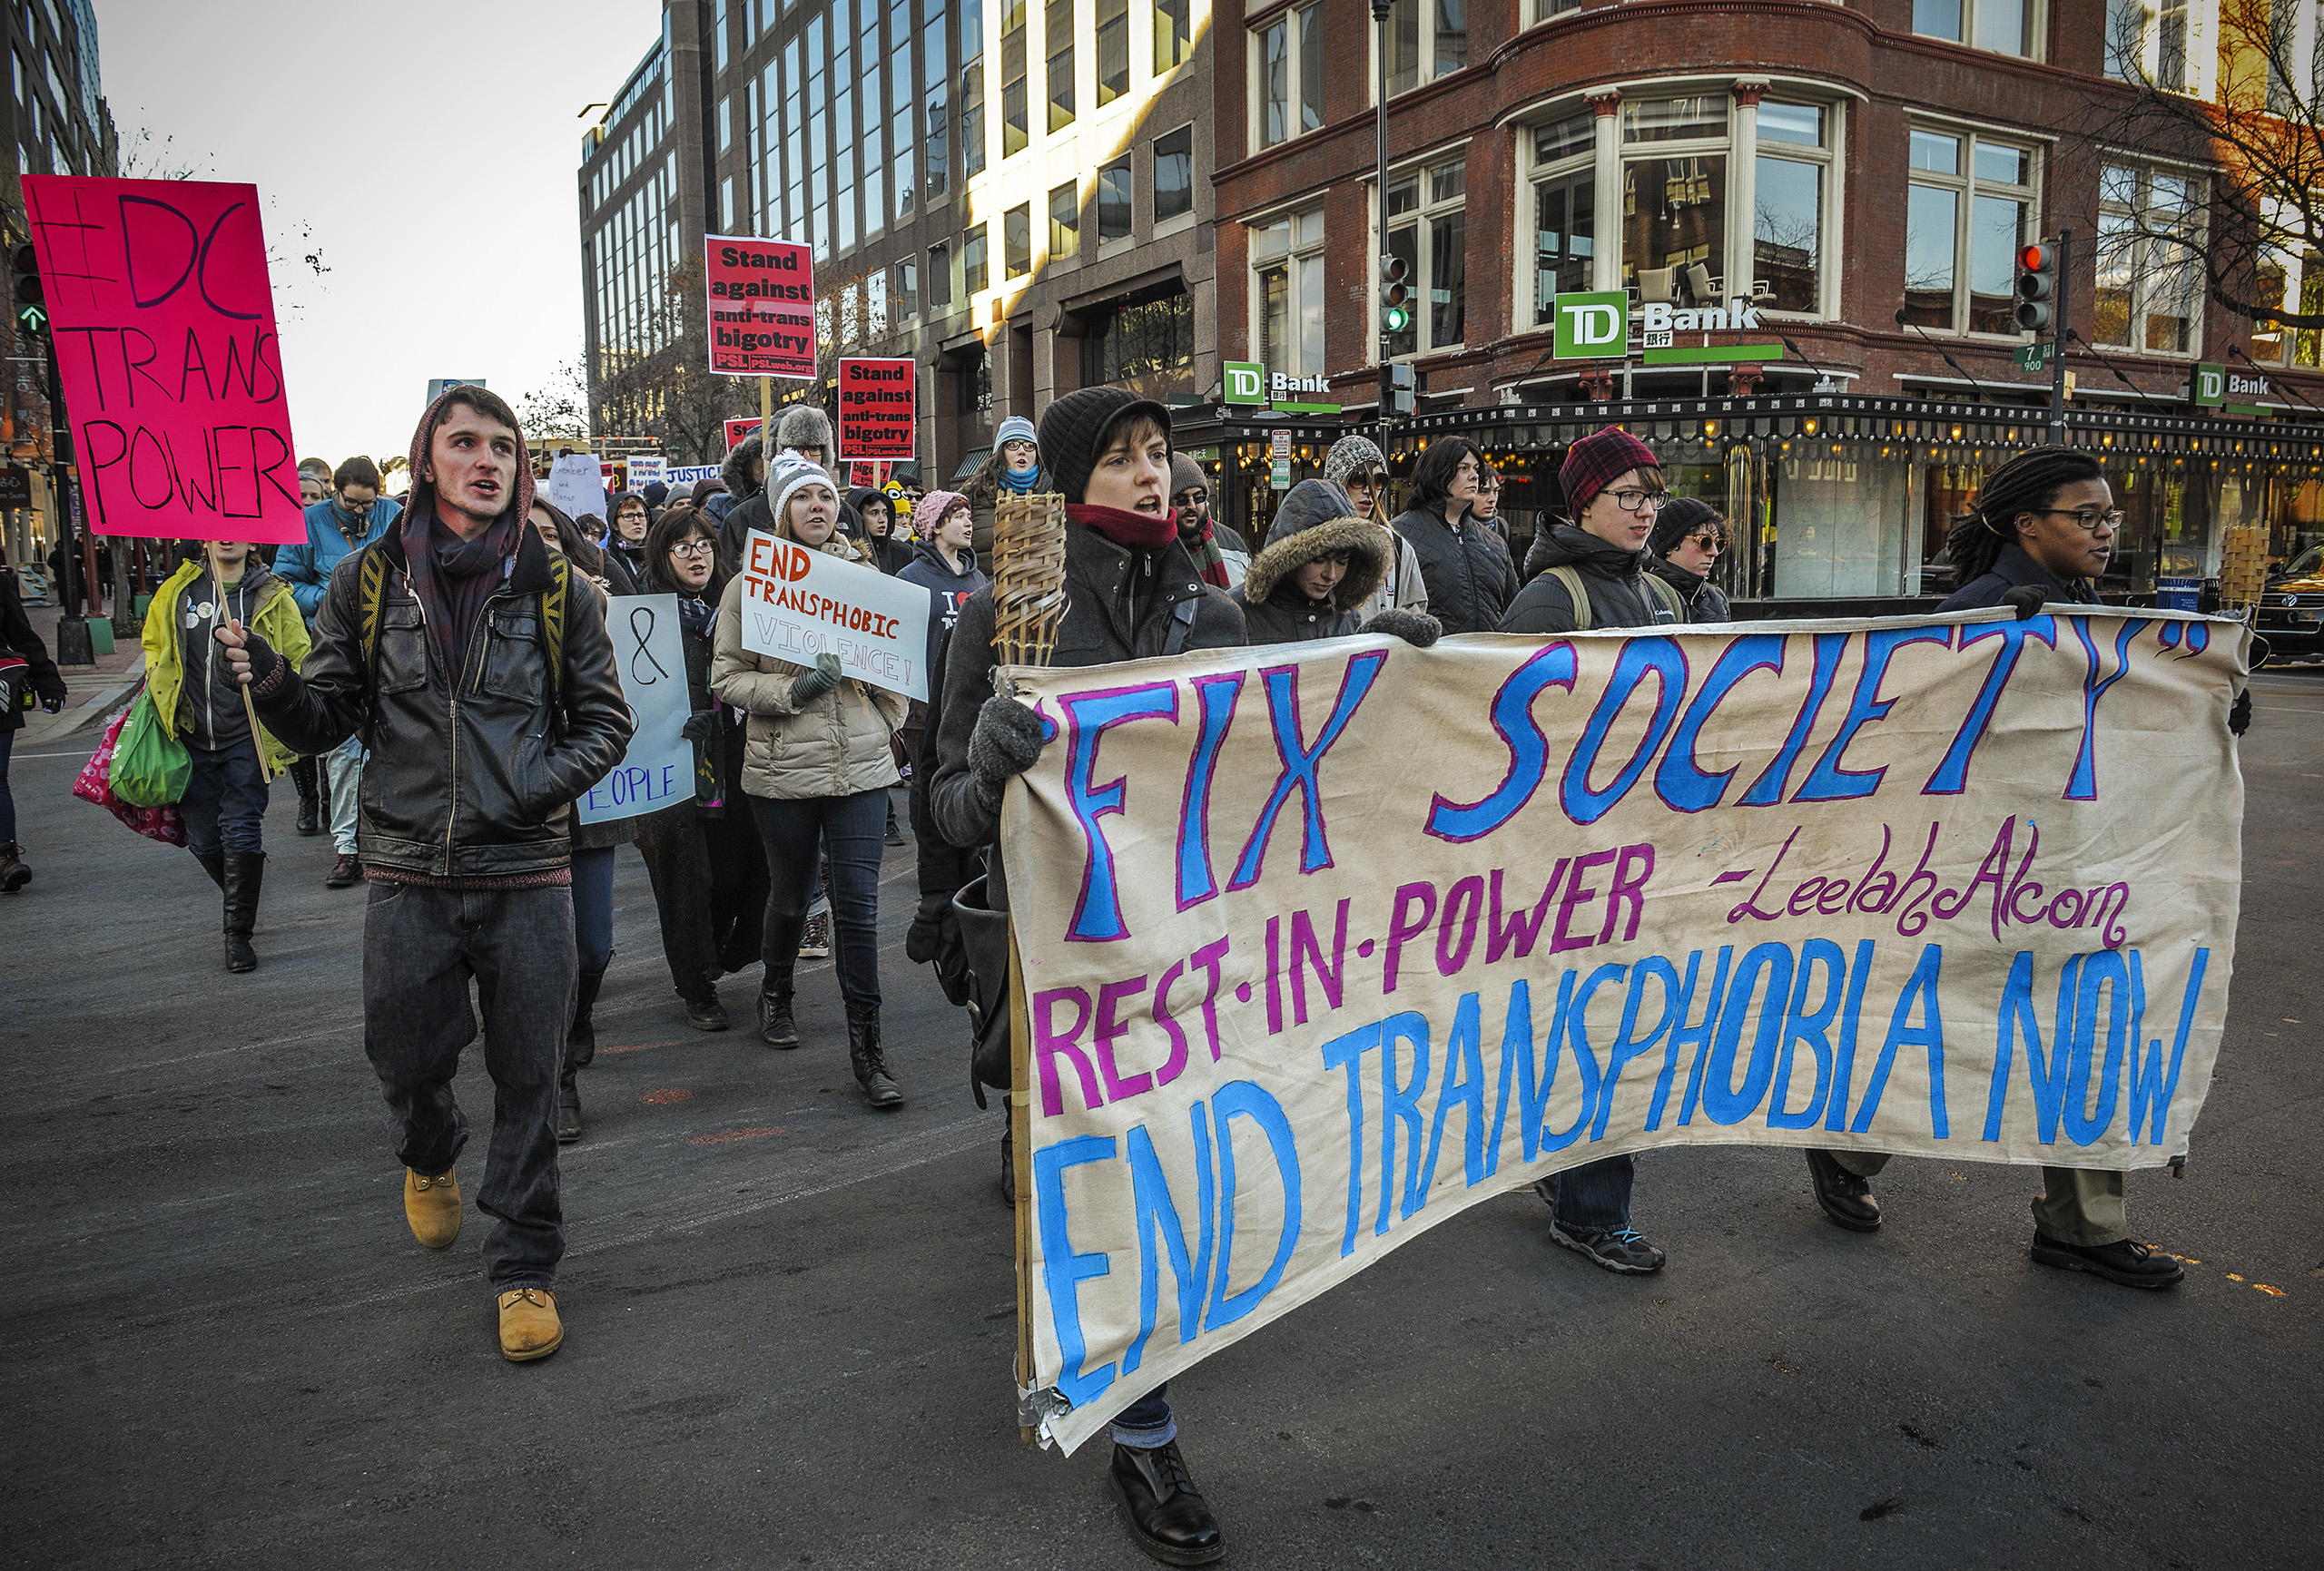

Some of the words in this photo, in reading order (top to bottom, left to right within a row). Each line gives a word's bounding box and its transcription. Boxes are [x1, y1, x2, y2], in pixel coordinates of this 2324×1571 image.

[31, 184, 263, 320] #DC
[721, 247, 797, 271] Stand
[712, 278, 810, 300] against
[714, 308, 811, 327] anti-trans
[1561, 304, 1620, 345] TD
[1644, 299, 1759, 331] Bank
[716, 327, 809, 355] bigotry
[1646, 333, 1670, 346] 銀行
[715, 353, 748, 368] PSL
[2026, 347, 2034, 361] 7
[2043, 344, 2051, 352] ST
[55, 325, 280, 412] TRANS
[752, 359, 812, 374] PSLweb.org
[850, 365, 904, 380] Stand
[2024, 360, 2041, 371] 900
[1228, 369, 1260, 396] TD
[1272, 372, 1331, 393] Bank
[2200, 371, 2221, 398] TD
[2229, 374, 2269, 396] Bank
[842, 388, 911, 405] against
[842, 410, 911, 422] anti-trans
[844, 425, 910, 442] bigotry
[843, 445, 865, 455] PSL
[868, 447, 911, 457] PSLweb.org
[84, 419, 302, 525] POWER
[750, 537, 811, 582] END
[744, 575, 900, 640] TRANSPHOBIC
[941, 591, 958, 615] I
[630, 606, 670, 685] &
[589, 765, 676, 810] EOPLE
[1931, 814, 2129, 950] Alcorn
[1033, 1078, 1302, 1410] END
[1321, 938, 1949, 1260] TRANSPHOBIA
[1983, 947, 2210, 1148] NOW
